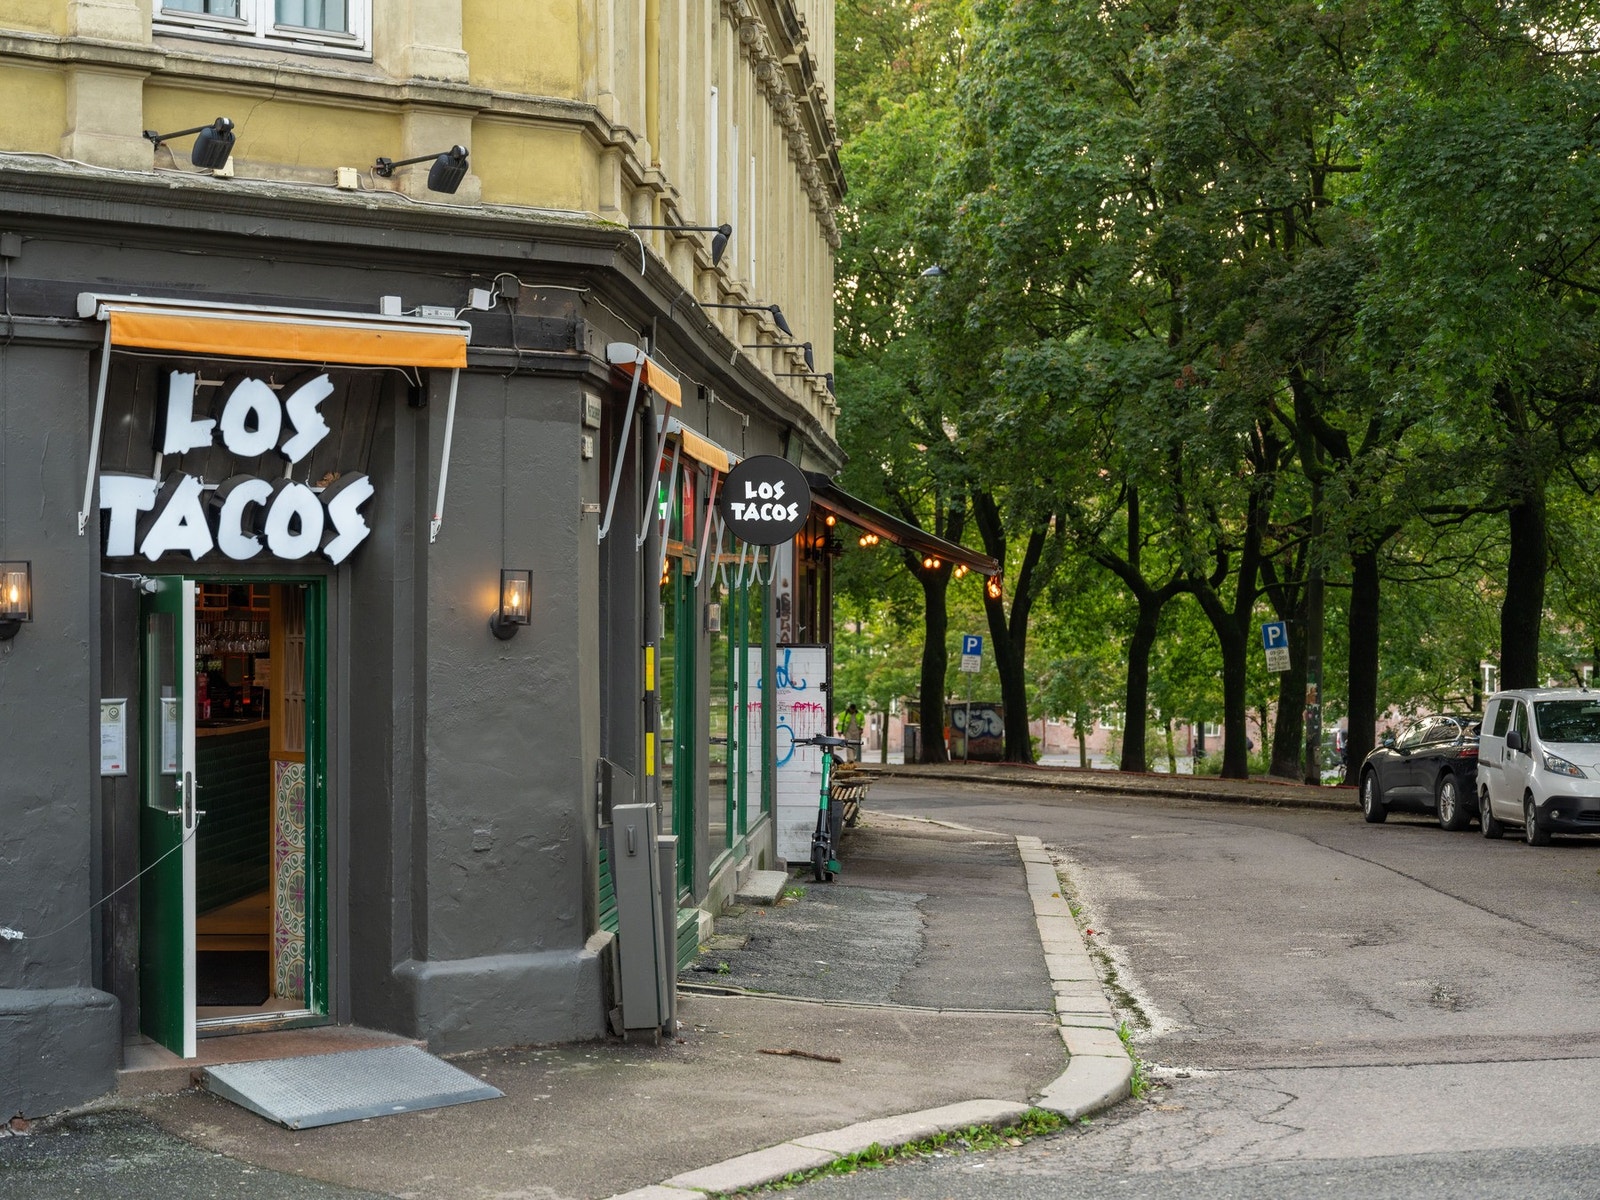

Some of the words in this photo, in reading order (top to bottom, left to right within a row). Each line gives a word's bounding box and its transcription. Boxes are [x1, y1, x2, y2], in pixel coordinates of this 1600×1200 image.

[163, 370, 334, 465] LOS
[744, 480, 786, 500] LOS
[100, 474, 375, 566] TACOS
[730, 501, 799, 522] TACOS
[967, 637, 978, 653] P
[1267, 626, 1281, 646] P
